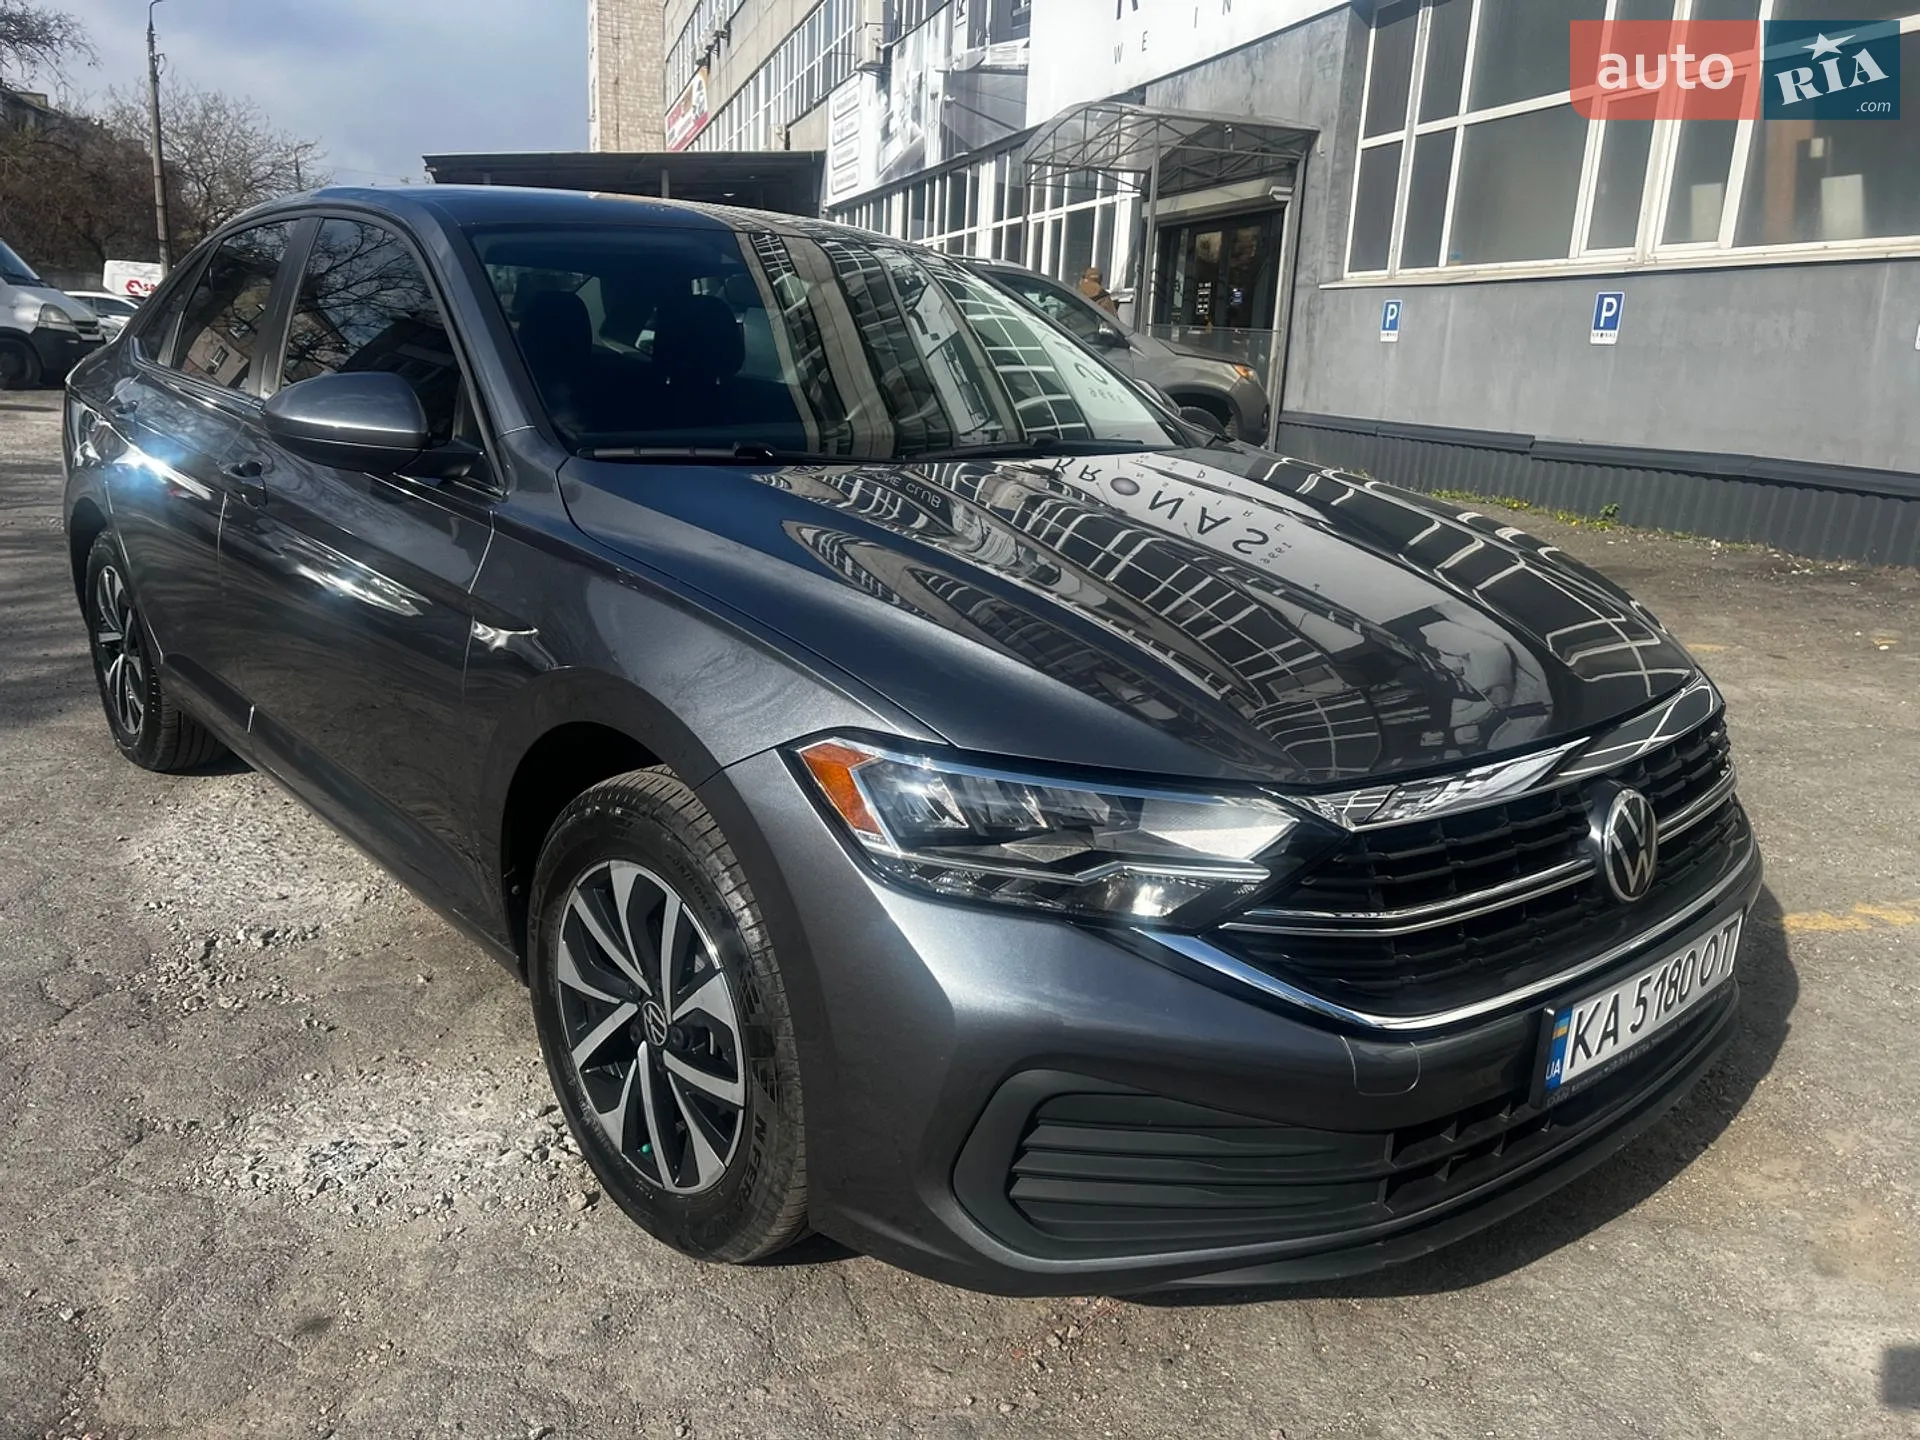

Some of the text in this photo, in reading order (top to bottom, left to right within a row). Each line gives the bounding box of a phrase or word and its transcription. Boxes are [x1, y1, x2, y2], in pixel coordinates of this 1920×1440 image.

[1385, 303, 1398, 328] P
[1599, 297, 1618, 328] P
[1567, 993, 1621, 1069] KA
[1629, 950, 1697, 1034] 5180
[1698, 916, 1742, 988] OT
[1545, 1062, 1560, 1080] UA
